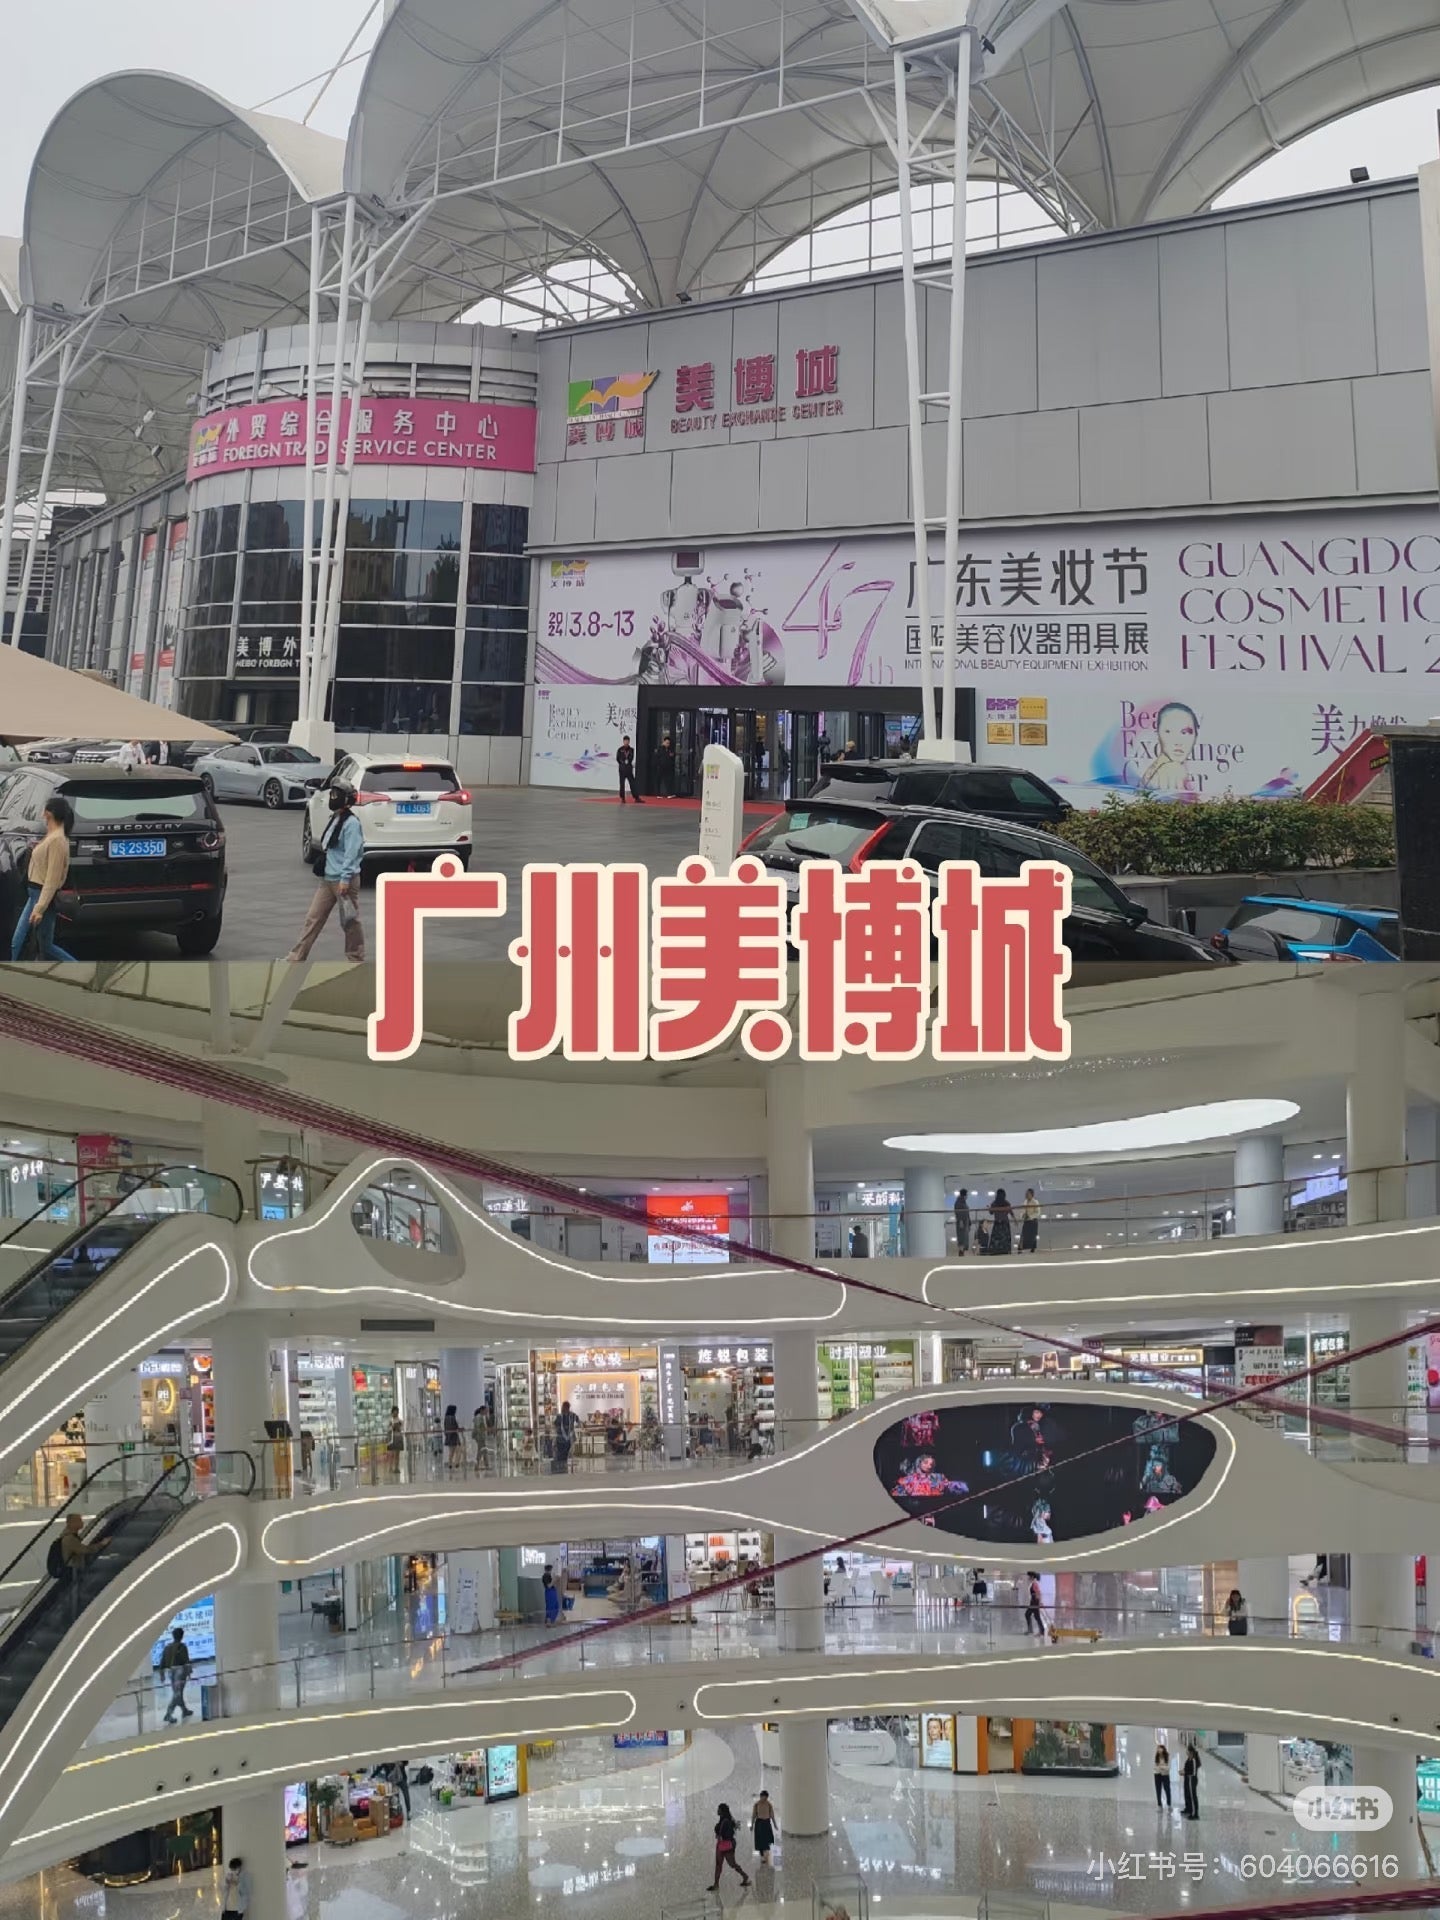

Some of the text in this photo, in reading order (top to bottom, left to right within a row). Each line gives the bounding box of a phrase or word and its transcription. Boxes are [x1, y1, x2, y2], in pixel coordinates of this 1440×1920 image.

[676, 345, 839, 413] 美博城
[671, 399, 844, 434] BEAUTY EXCHANGE CENTER
[223, 442, 283, 463] FOREIGN
[285, 440, 327, 457] TRAD
[424, 441, 497, 460] CENTER
[907, 547, 1148, 609] 广东美妆节
[981, 659, 1021, 670] BEAUTY
[1023, 659, 1083, 670] EQUIPMENT
[1087, 659, 1149, 671] EXHIBITION
[1182, 634, 1407, 673] FESTIVAL
[97, 823, 182, 831] DISCOVERY
